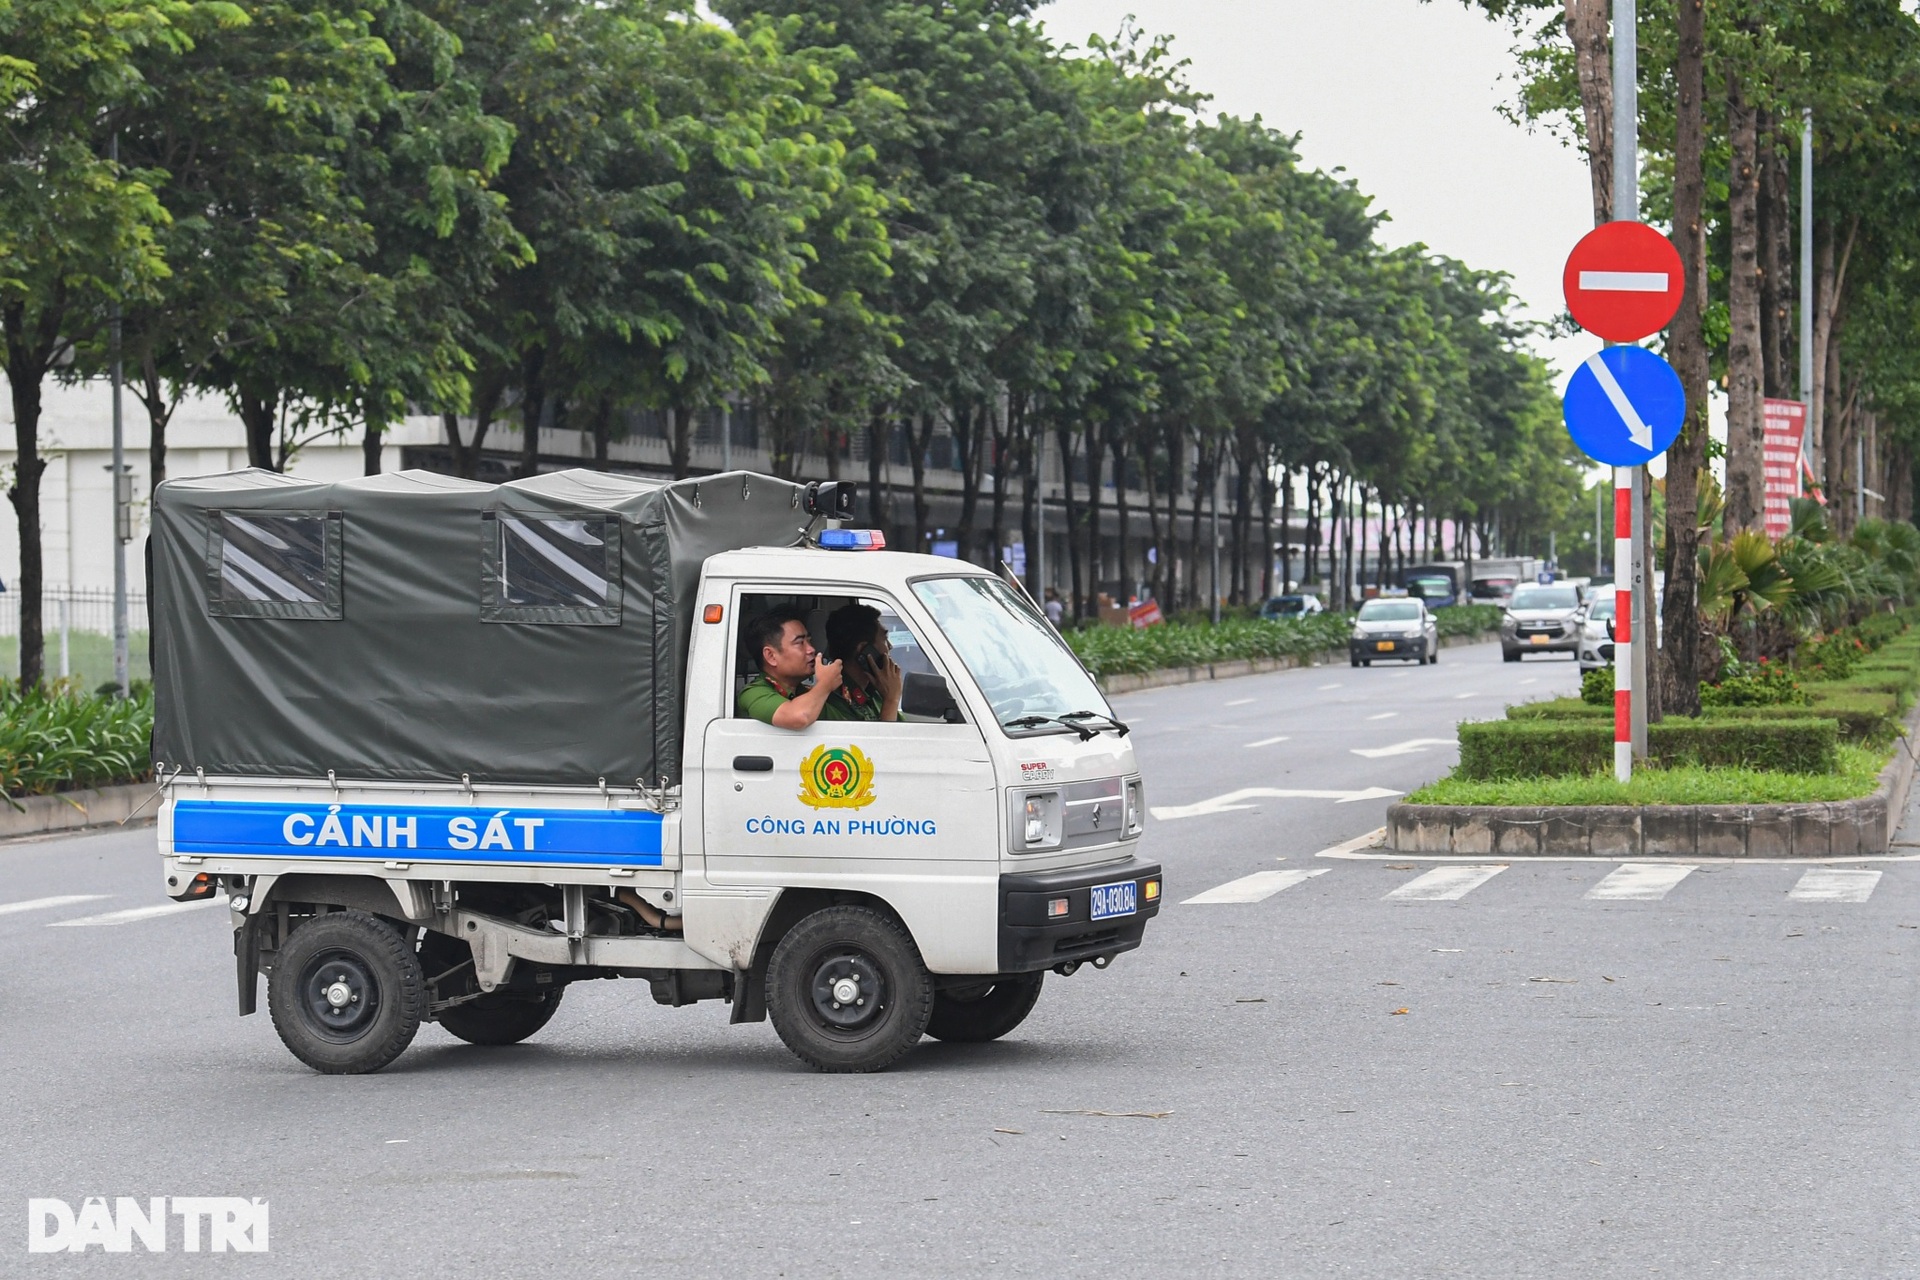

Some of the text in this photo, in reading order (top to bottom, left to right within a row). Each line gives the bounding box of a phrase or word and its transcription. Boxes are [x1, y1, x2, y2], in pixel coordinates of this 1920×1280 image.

[1020, 762, 1047, 770] SUPER
[1022, 769, 1054, 781] CARRY
[282, 804, 545, 851] CẢNH SÁT
[746, 814, 937, 835] CÔNG AN PHƯỜNG
